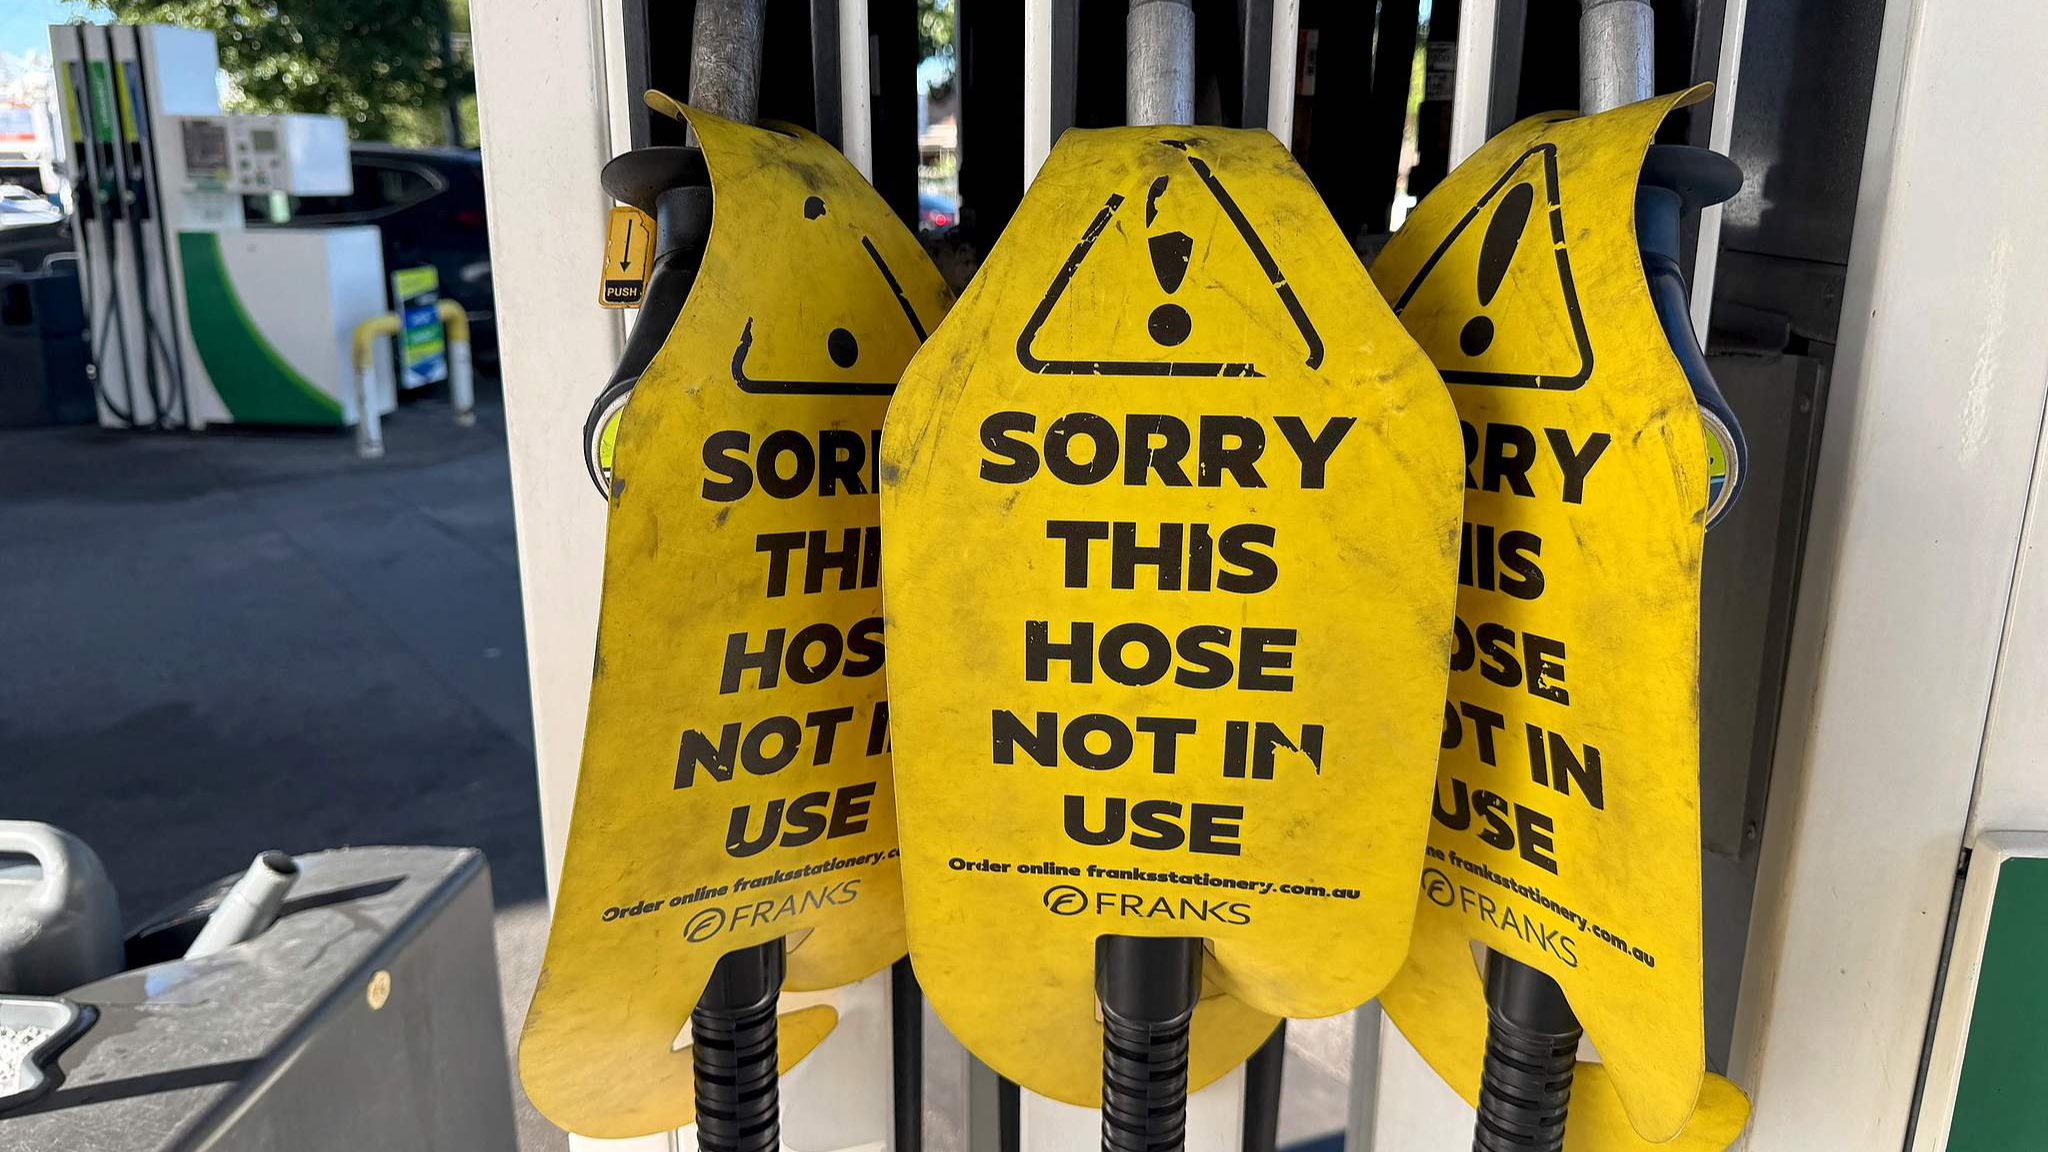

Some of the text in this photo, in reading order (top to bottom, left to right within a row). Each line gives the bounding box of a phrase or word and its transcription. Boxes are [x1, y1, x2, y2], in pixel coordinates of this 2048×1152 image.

[607, 287, 637, 297] PUSH
[979, 410, 1358, 489] SORRY
[1046, 520, 1279, 594] THIS
[1025, 620, 1298, 692] HOSE
[673, 705, 854, 790] NOT
[991, 709, 1325, 780] NOT IN
[1525, 722, 1605, 811] IN
[725, 781, 877, 858] USE
[1063, 794, 1244, 856] USE
[601, 901, 665, 922] Order
[669, 883, 728, 907] online
[729, 879, 862, 932] FRANKS
[948, 857, 1361, 899] Order online franksstationery.com.au
[1096, 891, 1251, 925] FRANKS
[1449, 850, 1656, 968] franksstationery.com.au
[1459, 885, 1578, 968] FRANKS
